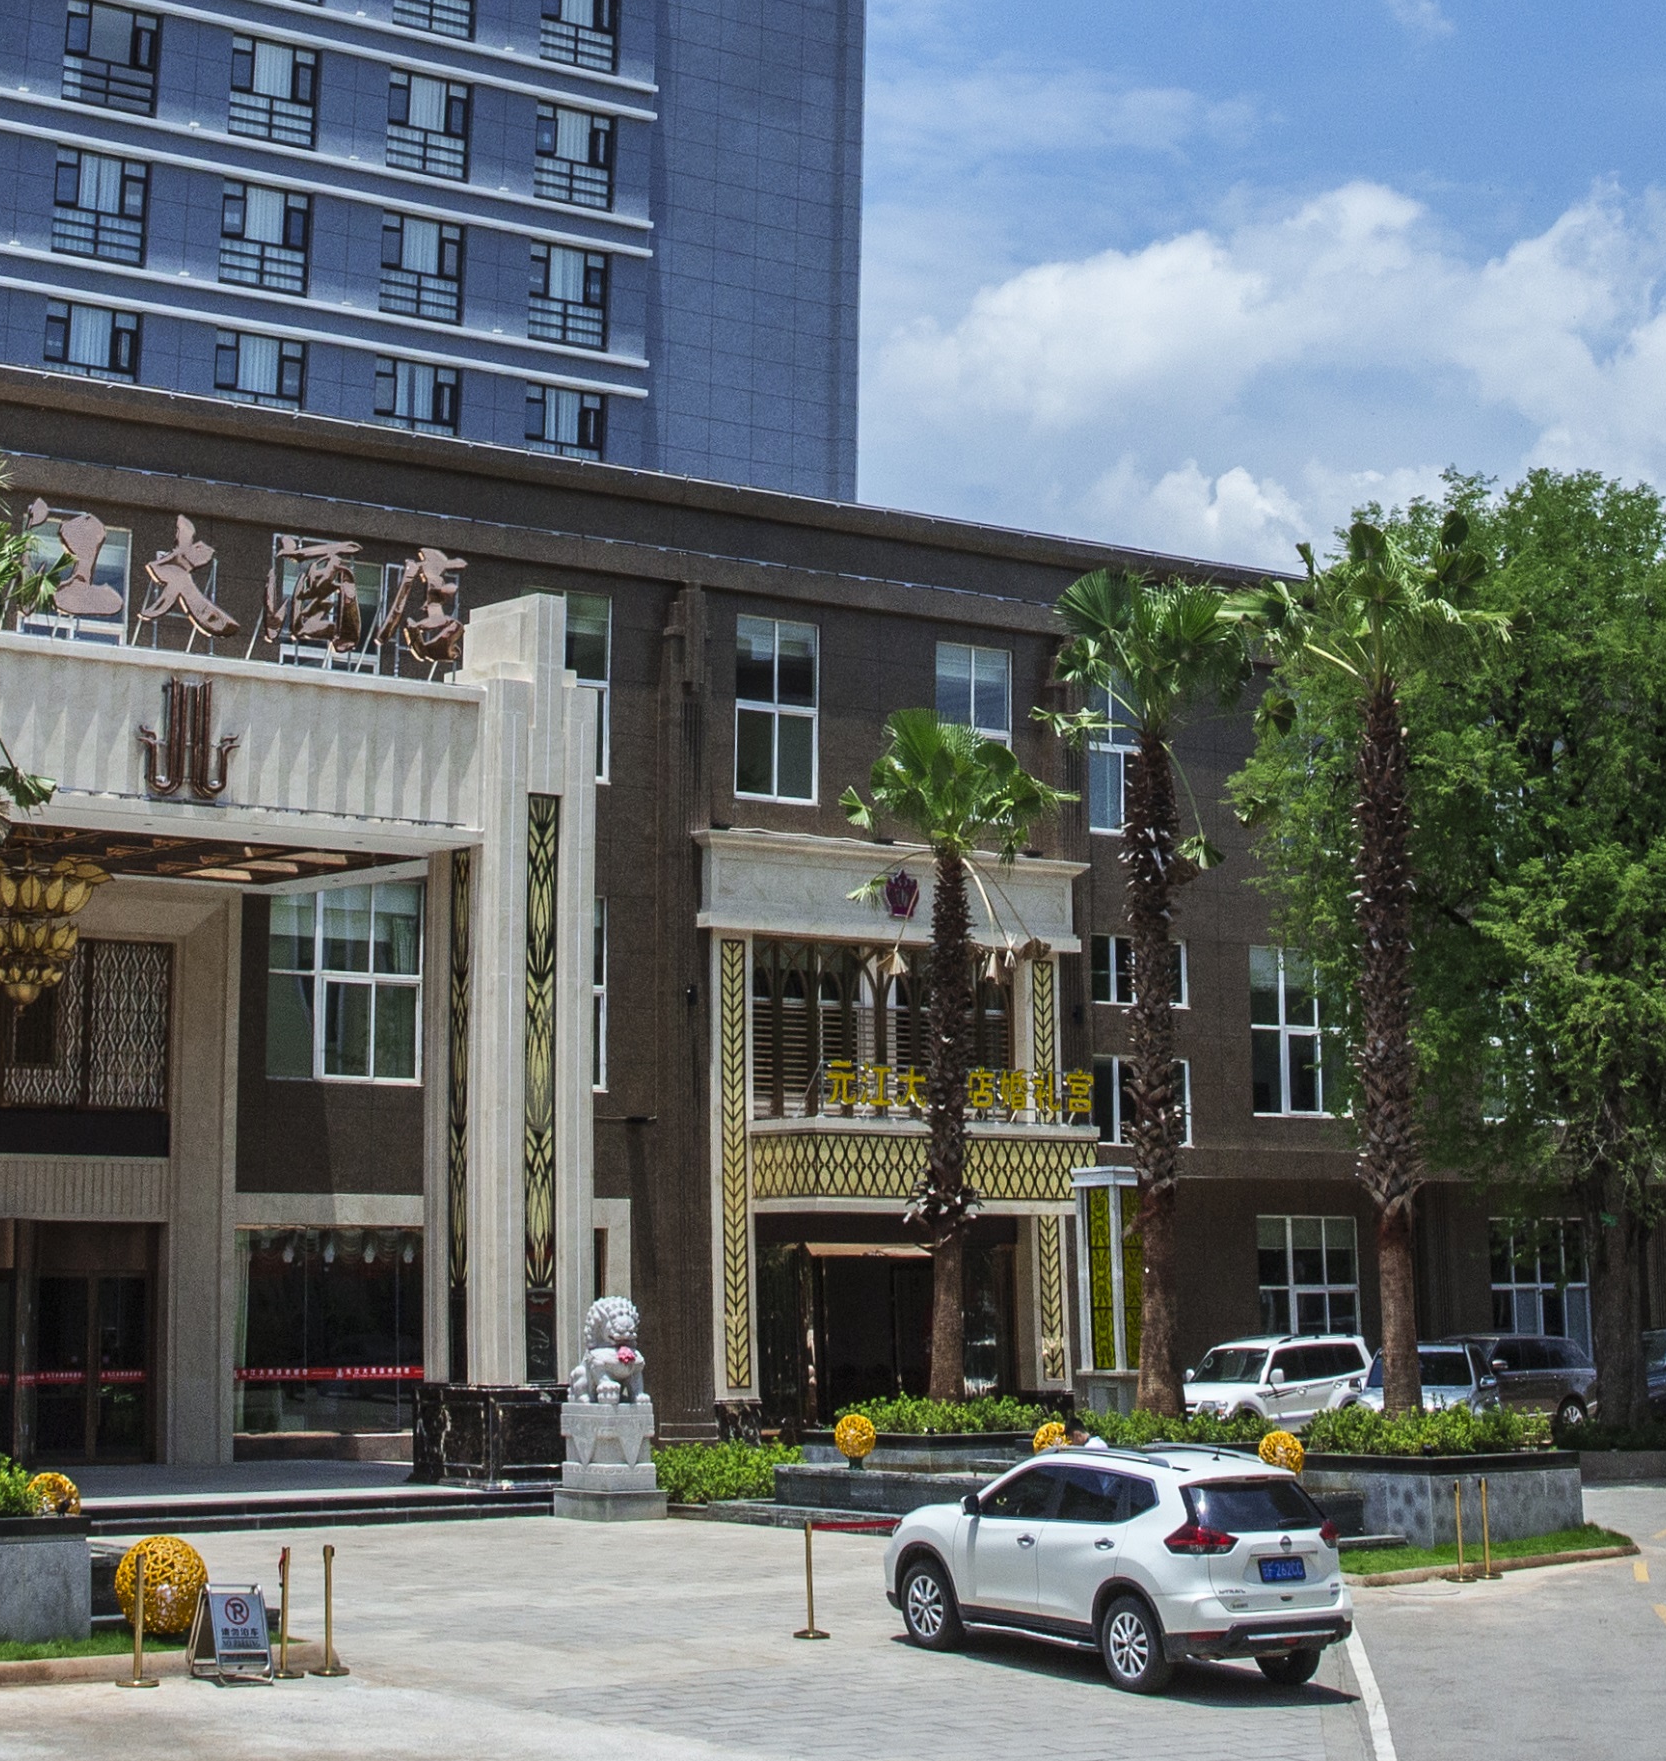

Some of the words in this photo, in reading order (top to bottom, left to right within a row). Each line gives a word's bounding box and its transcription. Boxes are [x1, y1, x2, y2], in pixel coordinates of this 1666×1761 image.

[825, 1059, 1094, 1113] 元江大店婚礼宫
